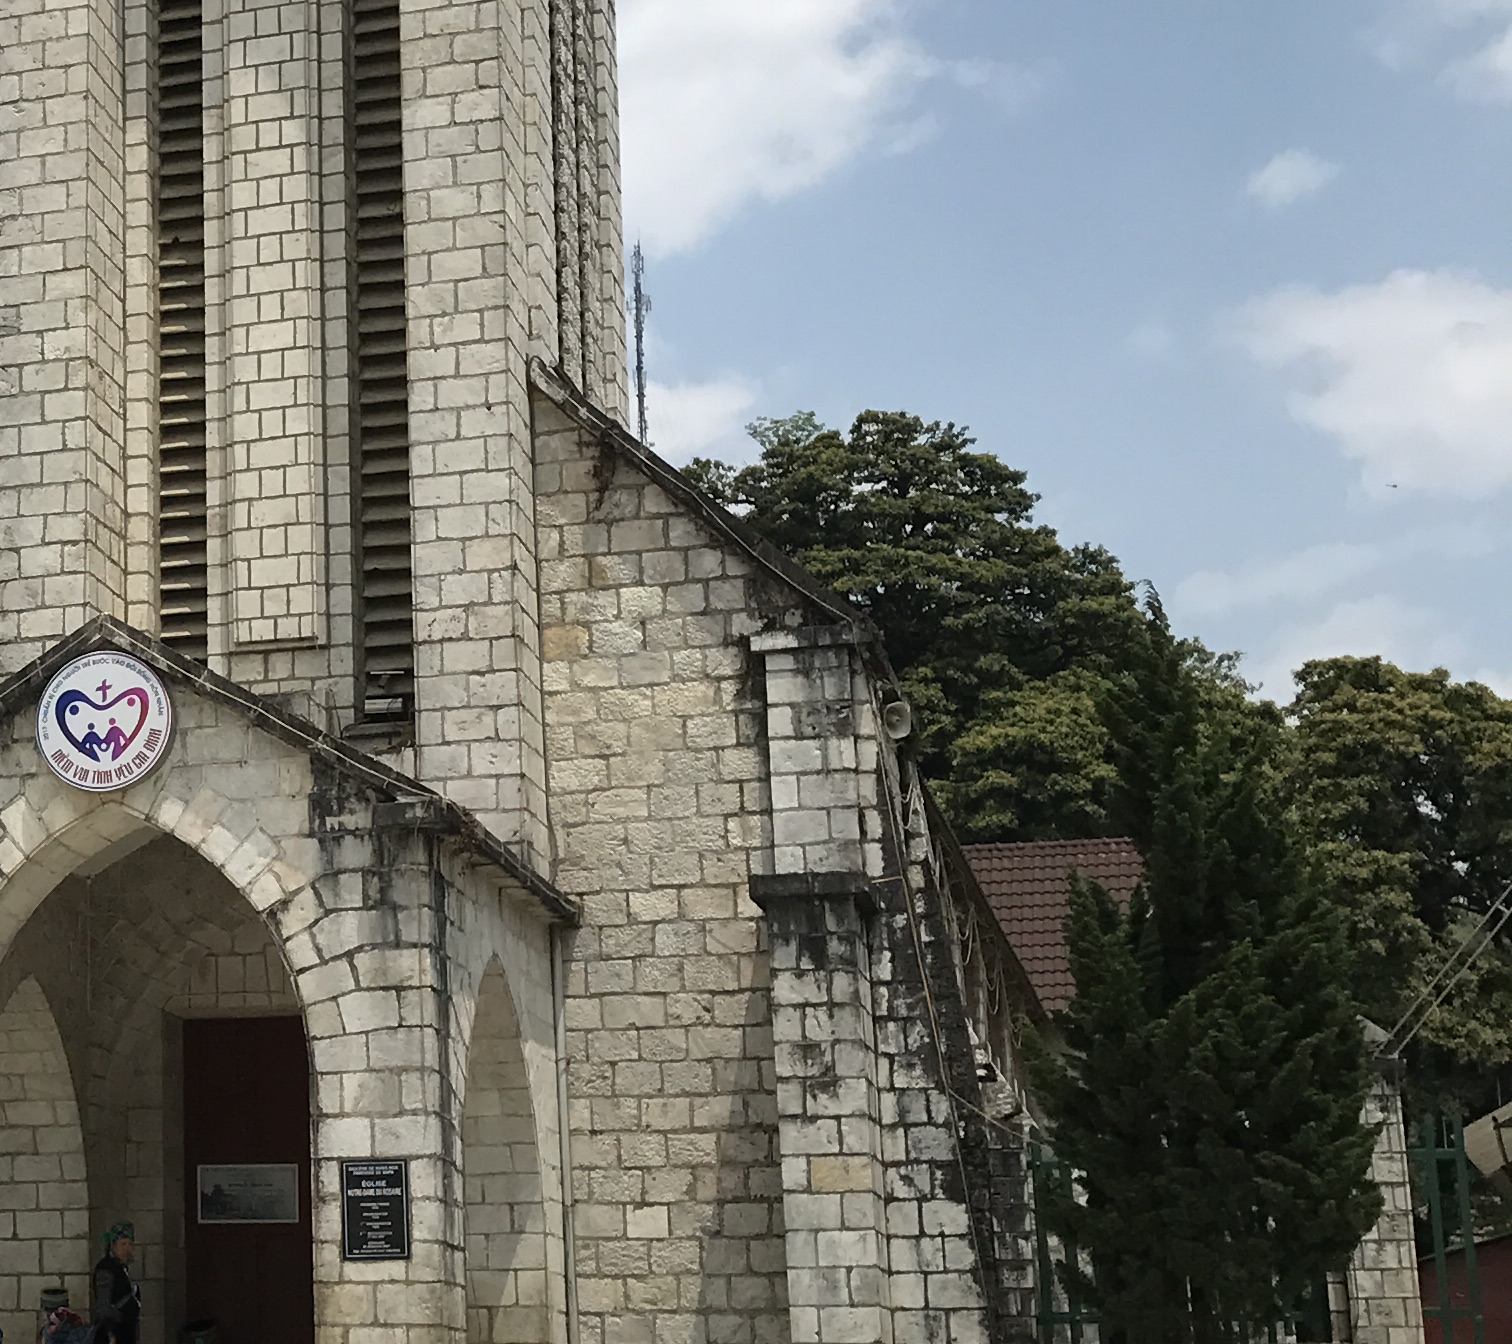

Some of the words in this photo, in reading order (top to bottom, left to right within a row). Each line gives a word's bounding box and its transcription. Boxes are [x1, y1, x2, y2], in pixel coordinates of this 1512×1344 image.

[72, 765, 90, 783] VUI
[92, 769, 113, 784] TÌNH
[114, 762, 134, 781] YÊU
[131, 750, 150, 769] GIA
